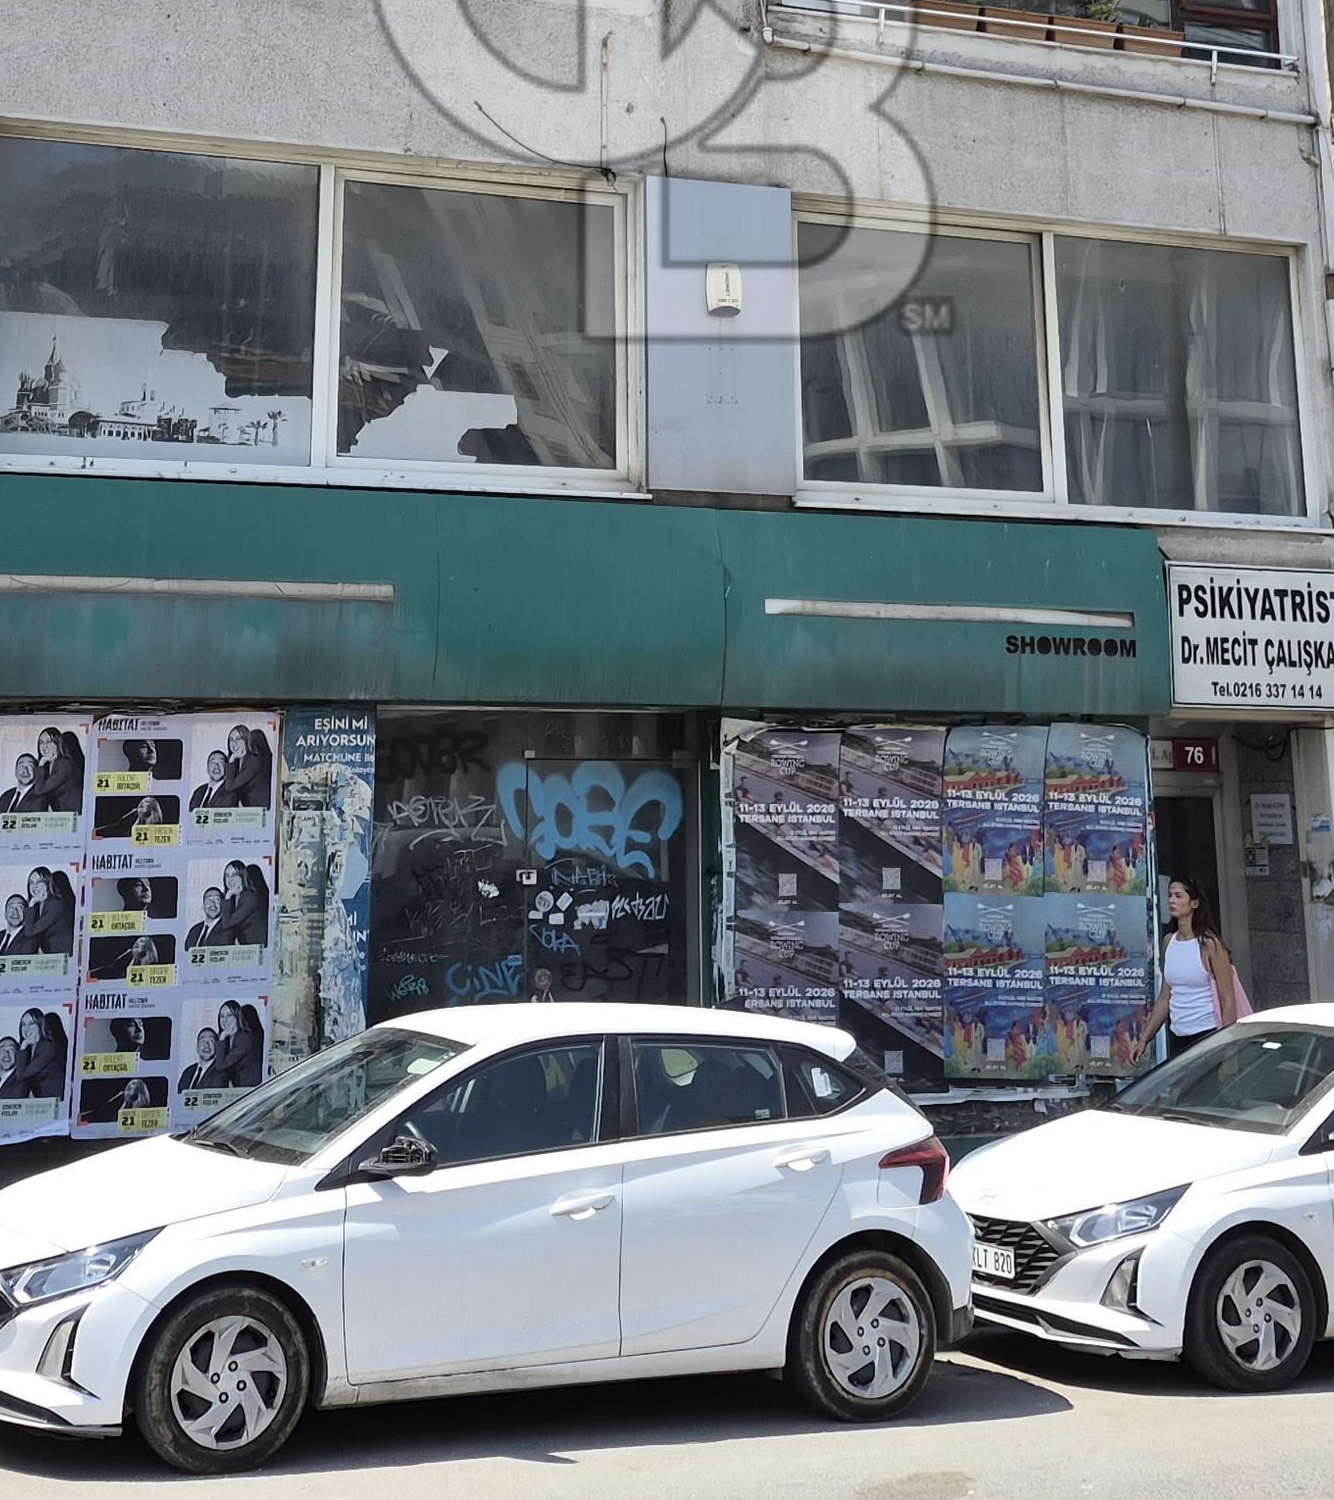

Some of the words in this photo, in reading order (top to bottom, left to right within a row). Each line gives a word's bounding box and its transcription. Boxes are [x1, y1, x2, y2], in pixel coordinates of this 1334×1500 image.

[1006, 634, 1136, 658] SHOWROOM
[1266, 683, 1286, 699] 337
[1291, 684, 1305, 699] 14
[1308, 685, 1322, 699] 14
[98, 718, 139, 731] HABITAT
[315, 716, 349, 732] EŞİNİ
[352, 716, 367, 729] Mİ
[304, 752, 363, 763] MATCHLINE
[1185, 746, 1204, 765] 76
[97, 780, 110, 788] 21
[947, 789, 972, 799] 11-13
[976, 789, 1007, 800] EYLÜL
[1048, 792, 1075, 801] 11-13
[1079, 792, 1111, 804] EYLÜL
[738, 804, 765, 814] 11-13
[770, 802, 803, 813] EYLÜL
[843, 799, 870, 808] 11-13
[874, 797, 906, 808] EYLÜL
[947, 799, 991, 810] TERSANE
[1049, 803, 1095, 813] TERSANE
[739, 814, 785, 823] TERSANE
[843, 809, 888, 818] TERSANE
[2, 820, 16, 829] 22
[196, 815, 209, 824] 22
[136, 833, 148, 842] 21
[92, 854, 133, 870] HABITAT
[91, 920, 104, 928] 21
[192, 954, 205, 963] 22
[947, 967, 973, 977] 11-13
[978, 966, 1009, 978] EYLÜL
[1049, 966, 1076, 975] 11-13
[1079, 965, 1114, 976] EYLÜL
[131, 974, 143, 982] 21
[843, 979, 870, 988] 11-13
[874, 976, 908, 988] EYLÜL
[947, 978, 993, 987] TERSANE
[1049, 976, 1095, 986] TERSANE
[738, 988, 765, 997] 11-13
[769, 985, 801, 997] EYLÜL
[843, 990, 890, 999] TERSANE
[85, 994, 127, 1010] HABITAT
[744, 999, 783, 1008] ERSANE
[83, 1061, 96, 1070] 21
[184, 1097, 198, 1106] 22
[122, 1117, 135, 1126] 21
[994, 1252, 1012, 1274] 820
